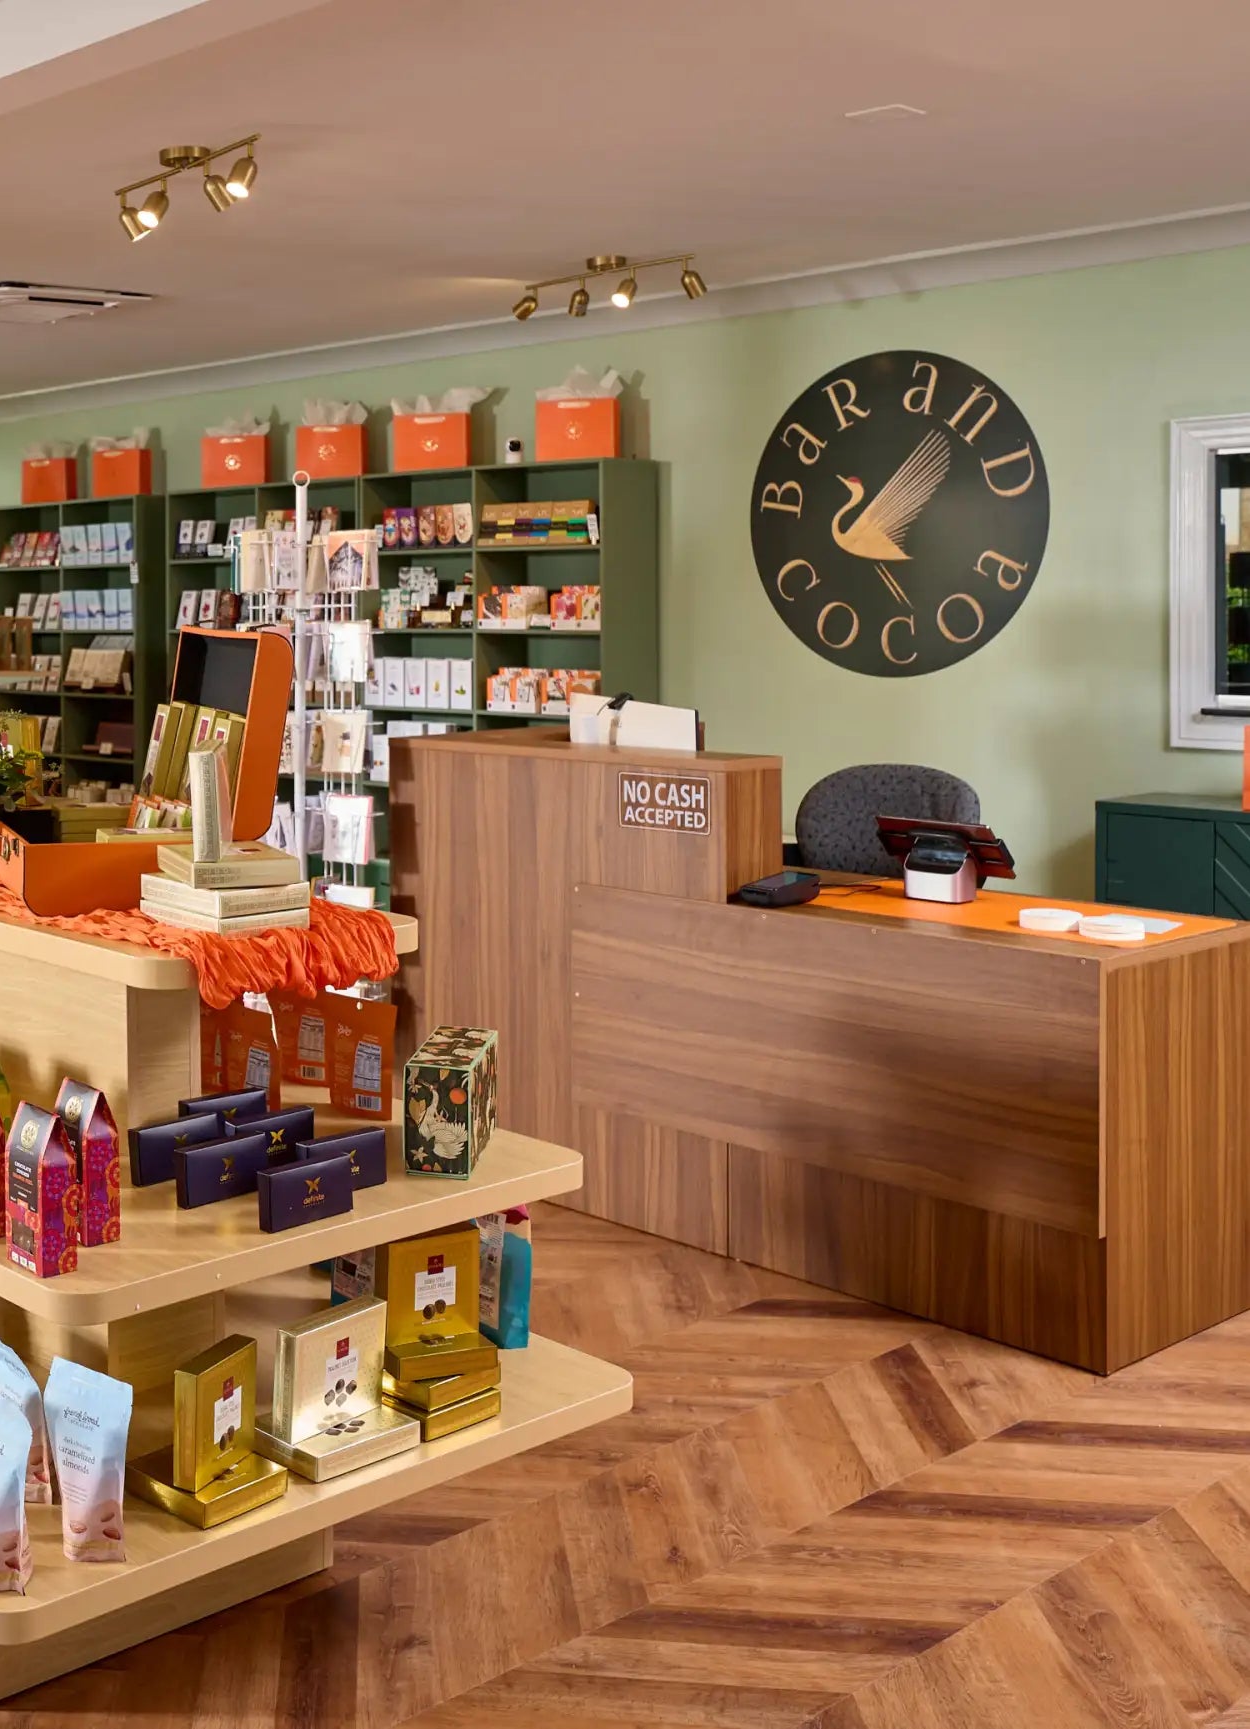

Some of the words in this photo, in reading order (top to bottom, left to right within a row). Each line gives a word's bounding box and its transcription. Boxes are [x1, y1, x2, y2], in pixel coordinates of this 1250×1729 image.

[623, 780, 650, 804] NO
[654, 783, 705, 809] CASH
[624, 806, 706, 829] ACCEPTED
[58, 1445, 96, 1465] caramelized
[62, 1459, 90, 1475] almonds
